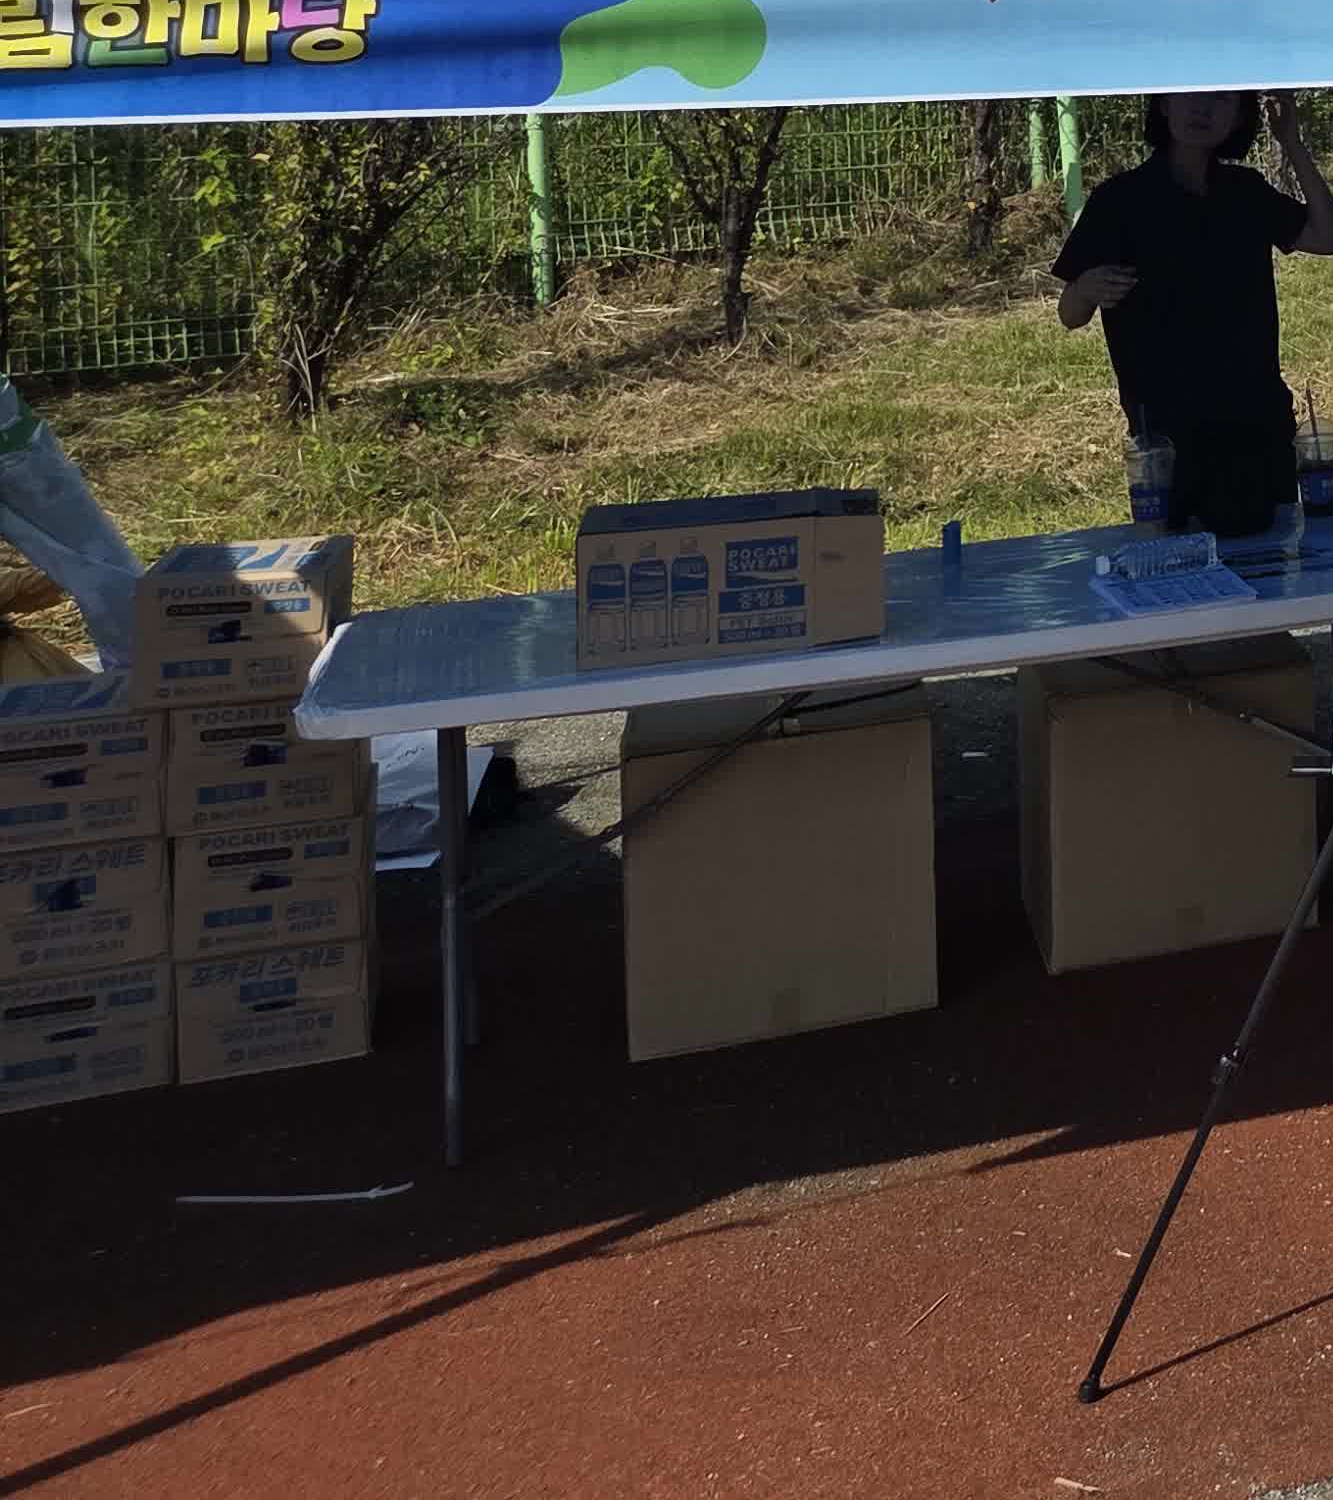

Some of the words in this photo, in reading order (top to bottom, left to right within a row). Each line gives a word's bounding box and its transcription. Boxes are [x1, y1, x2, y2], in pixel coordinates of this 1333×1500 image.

[728, 545, 796, 560] POCARI
[728, 557, 789, 573] SWEAT
[240, 579, 311, 596] SWEAT
